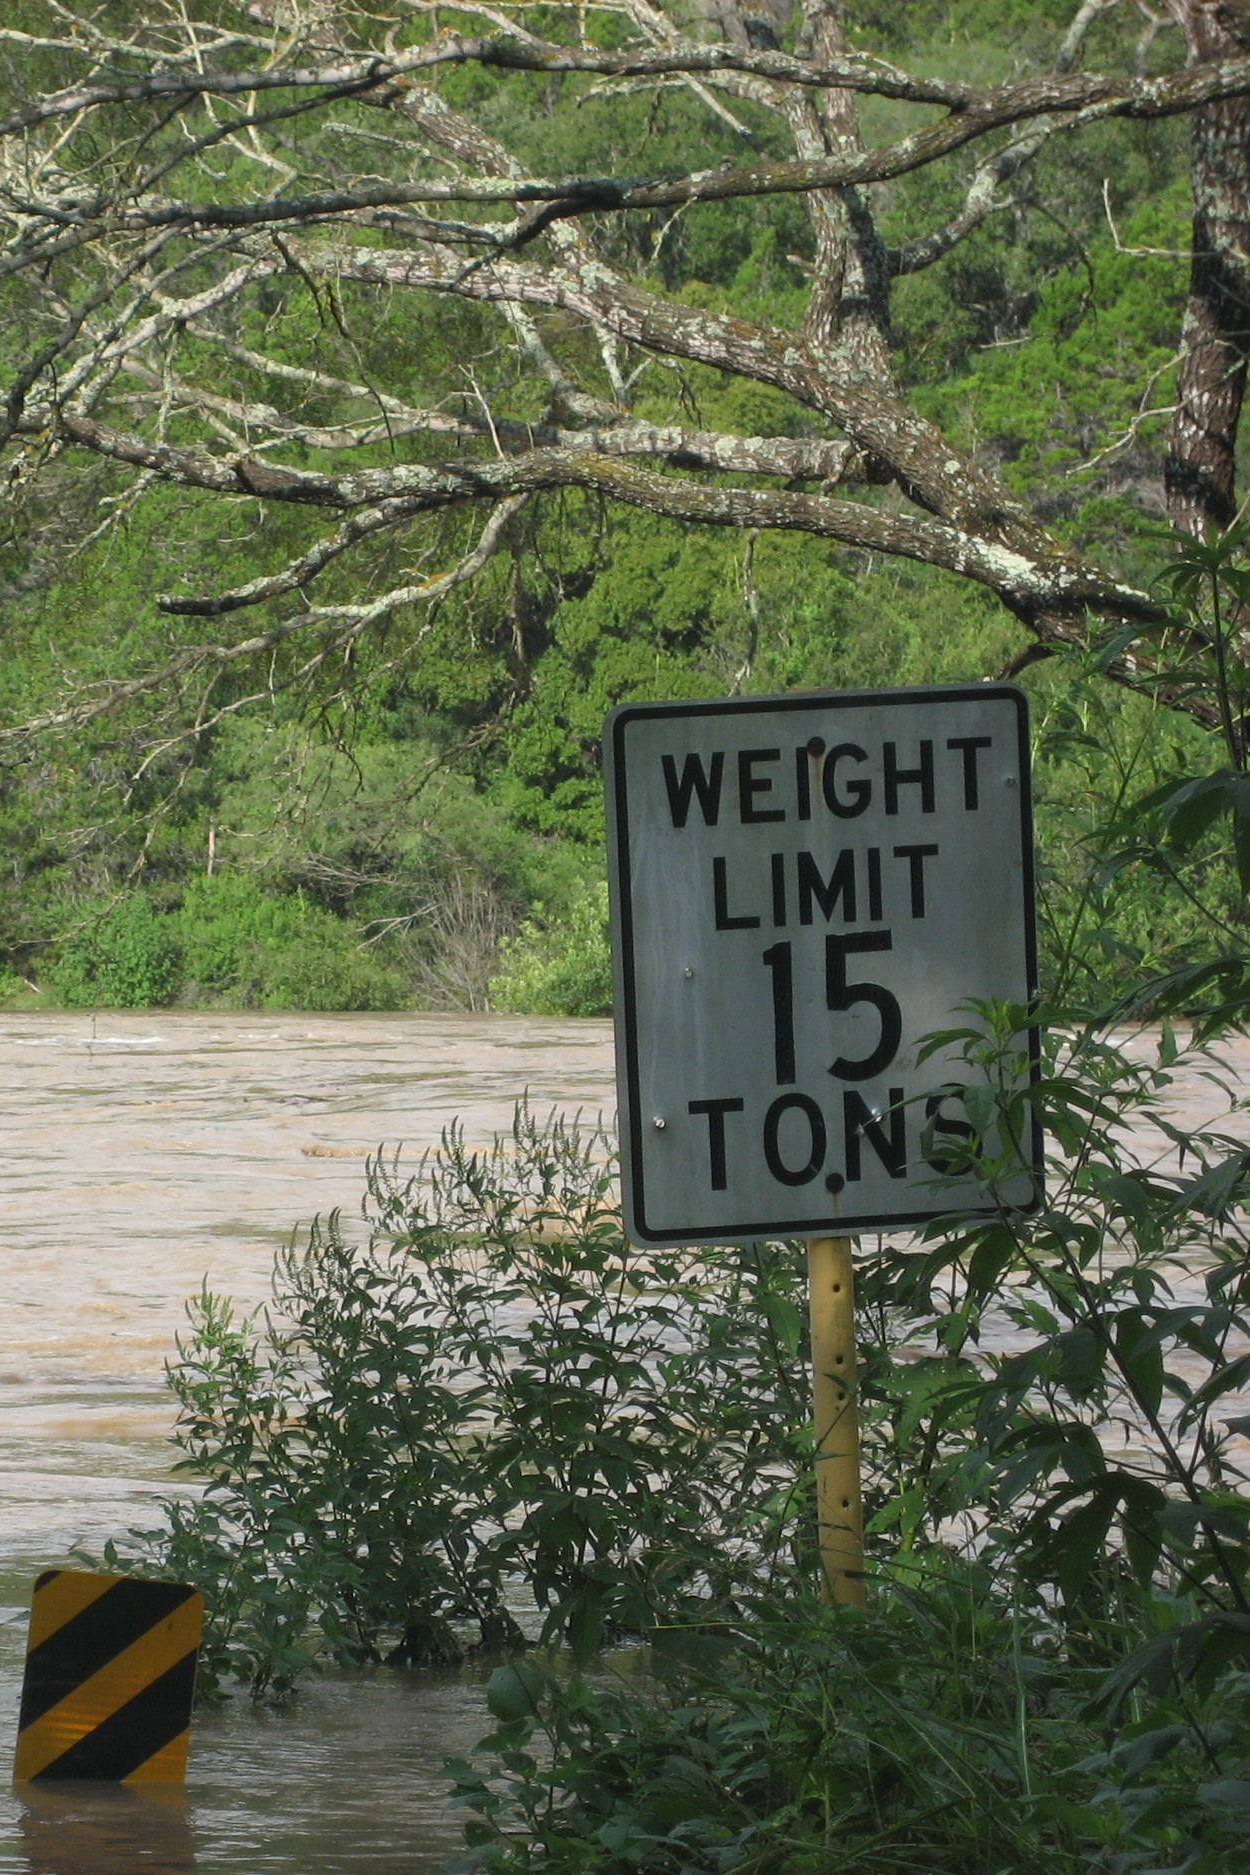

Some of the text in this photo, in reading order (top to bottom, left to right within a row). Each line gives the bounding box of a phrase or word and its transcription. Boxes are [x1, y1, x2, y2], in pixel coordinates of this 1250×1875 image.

[661, 737, 992, 828] WEIGHT
[713, 844, 939, 931] LIMIT
[763, 930, 903, 1085] 15
[688, 1082, 984, 1191] TONS
